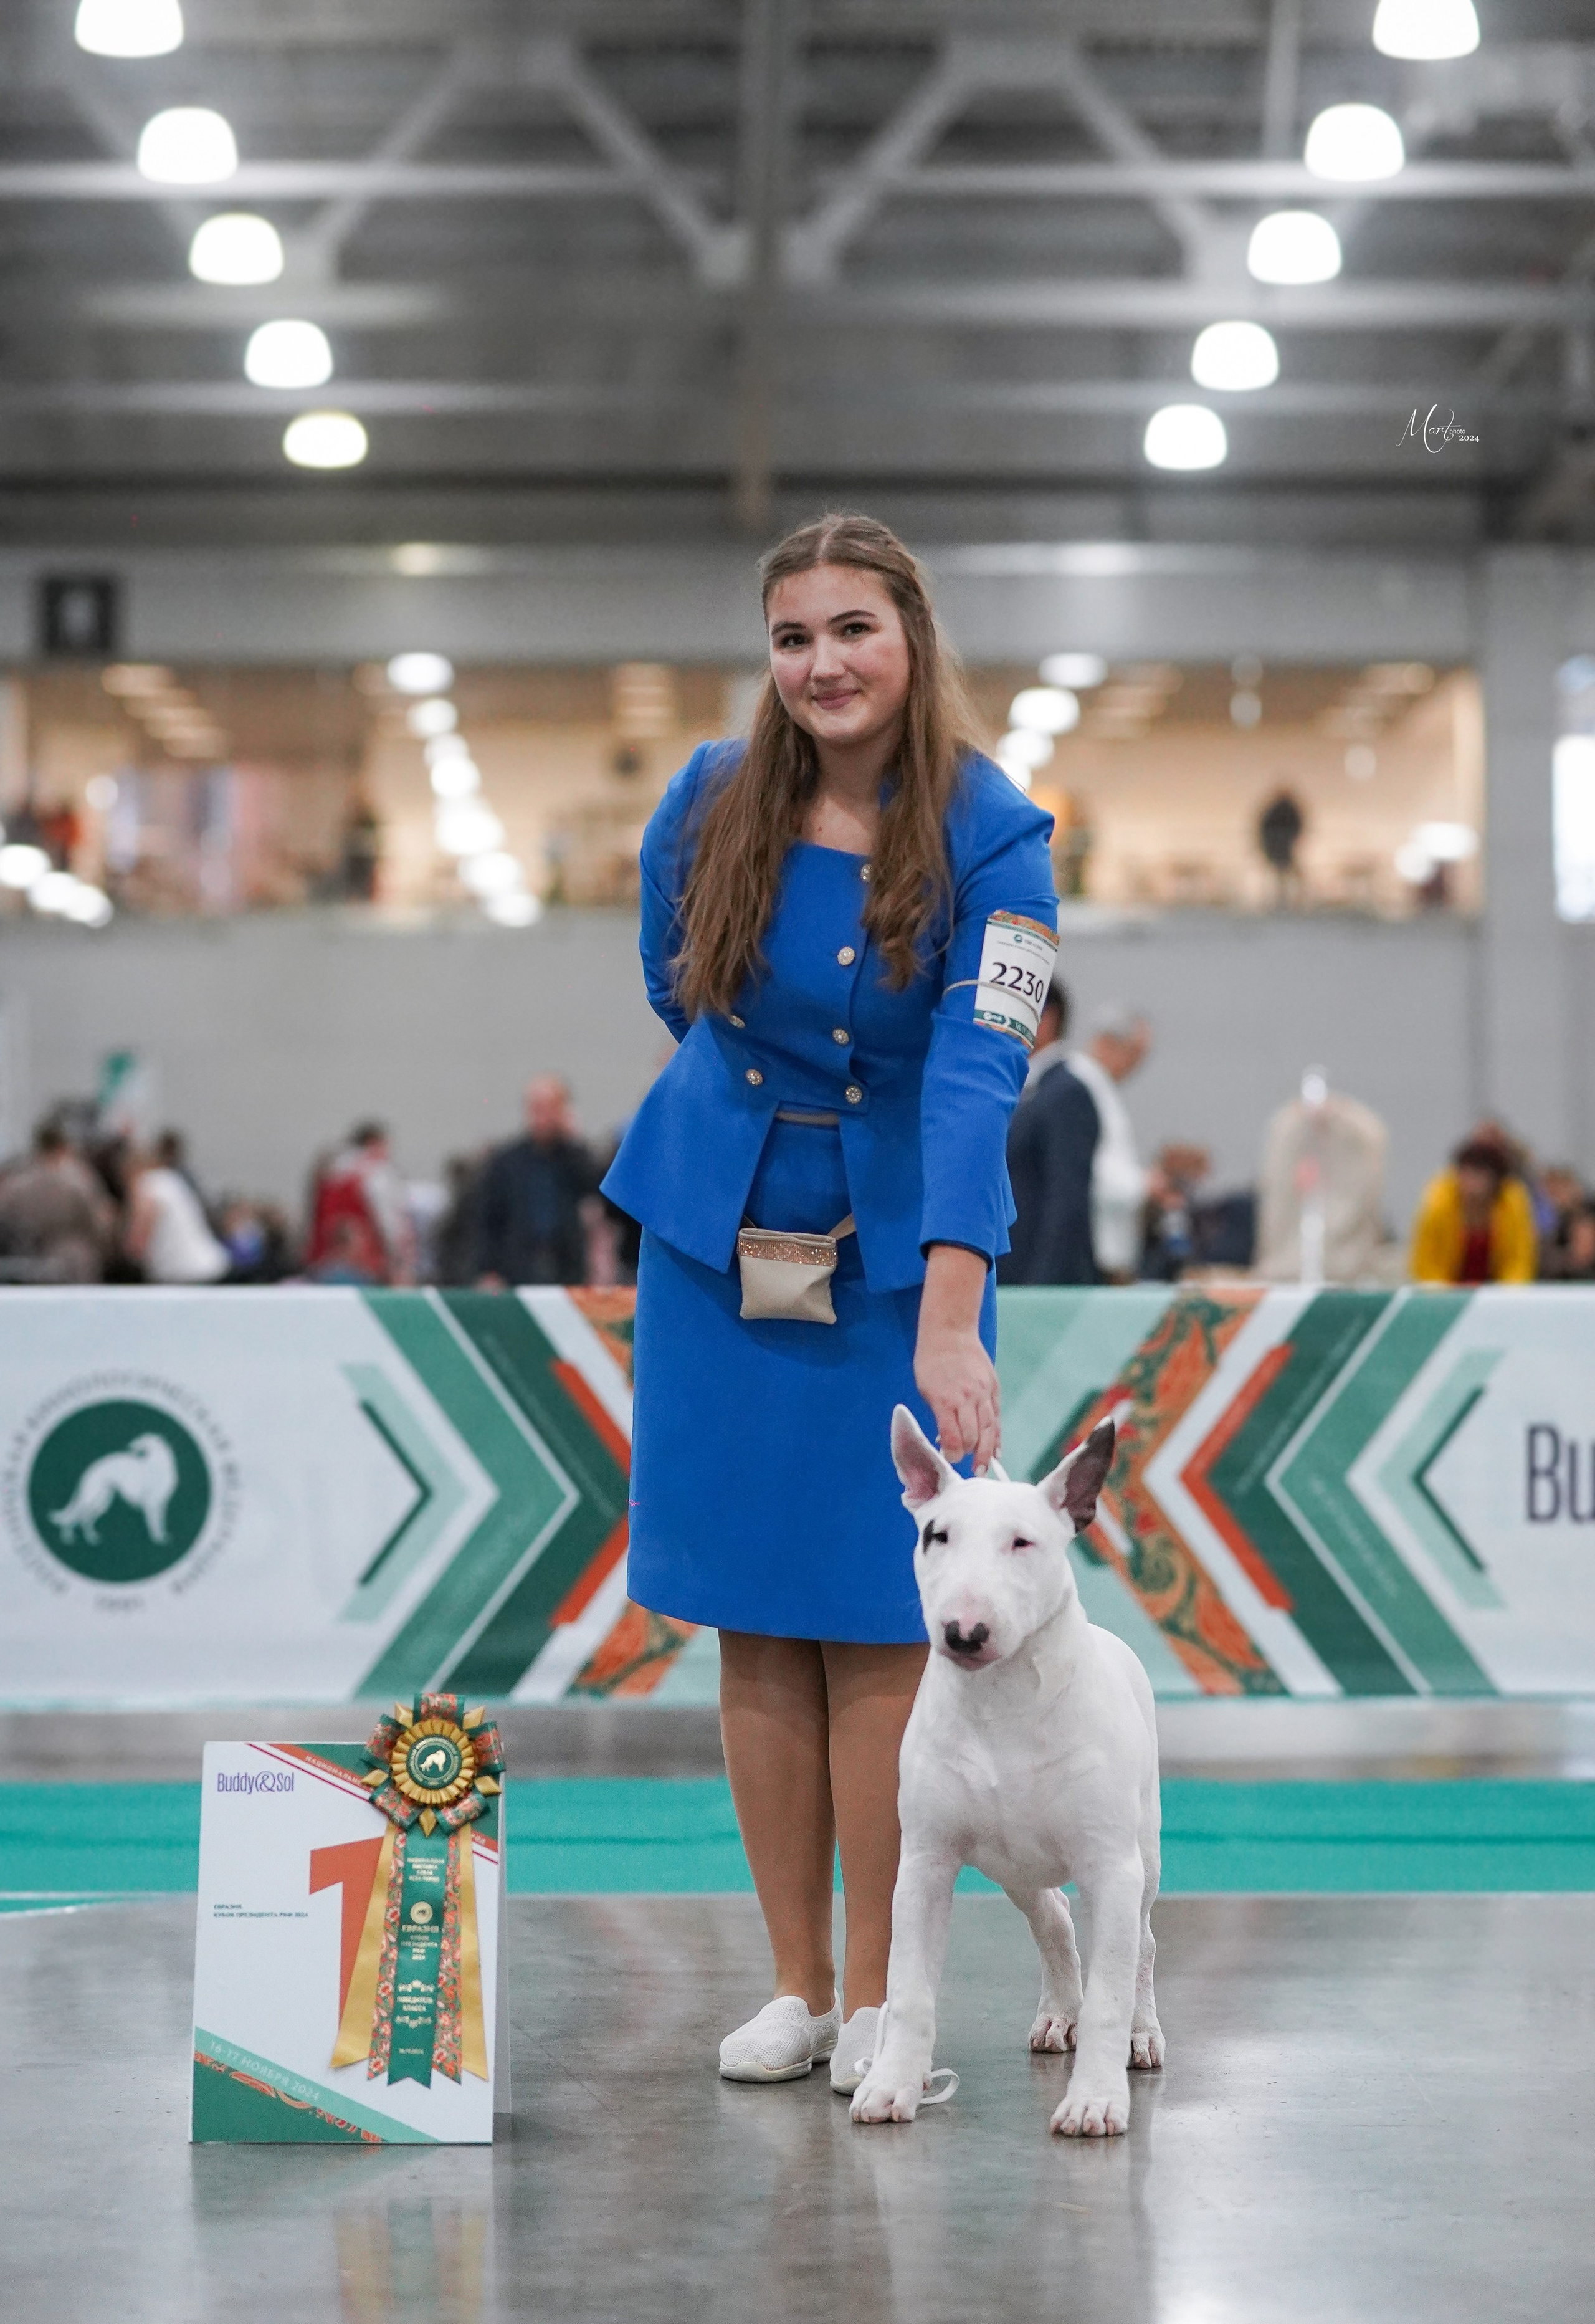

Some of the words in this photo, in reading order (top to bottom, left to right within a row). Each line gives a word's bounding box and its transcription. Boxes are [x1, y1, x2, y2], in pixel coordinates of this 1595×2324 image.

[989, 962, 1044, 1003] 2230
[1528, 1423, 1595, 1523] Bu
[240, 2057, 290, 2085] НОЯБРЯ
[292, 2081, 320, 2101] 2024
